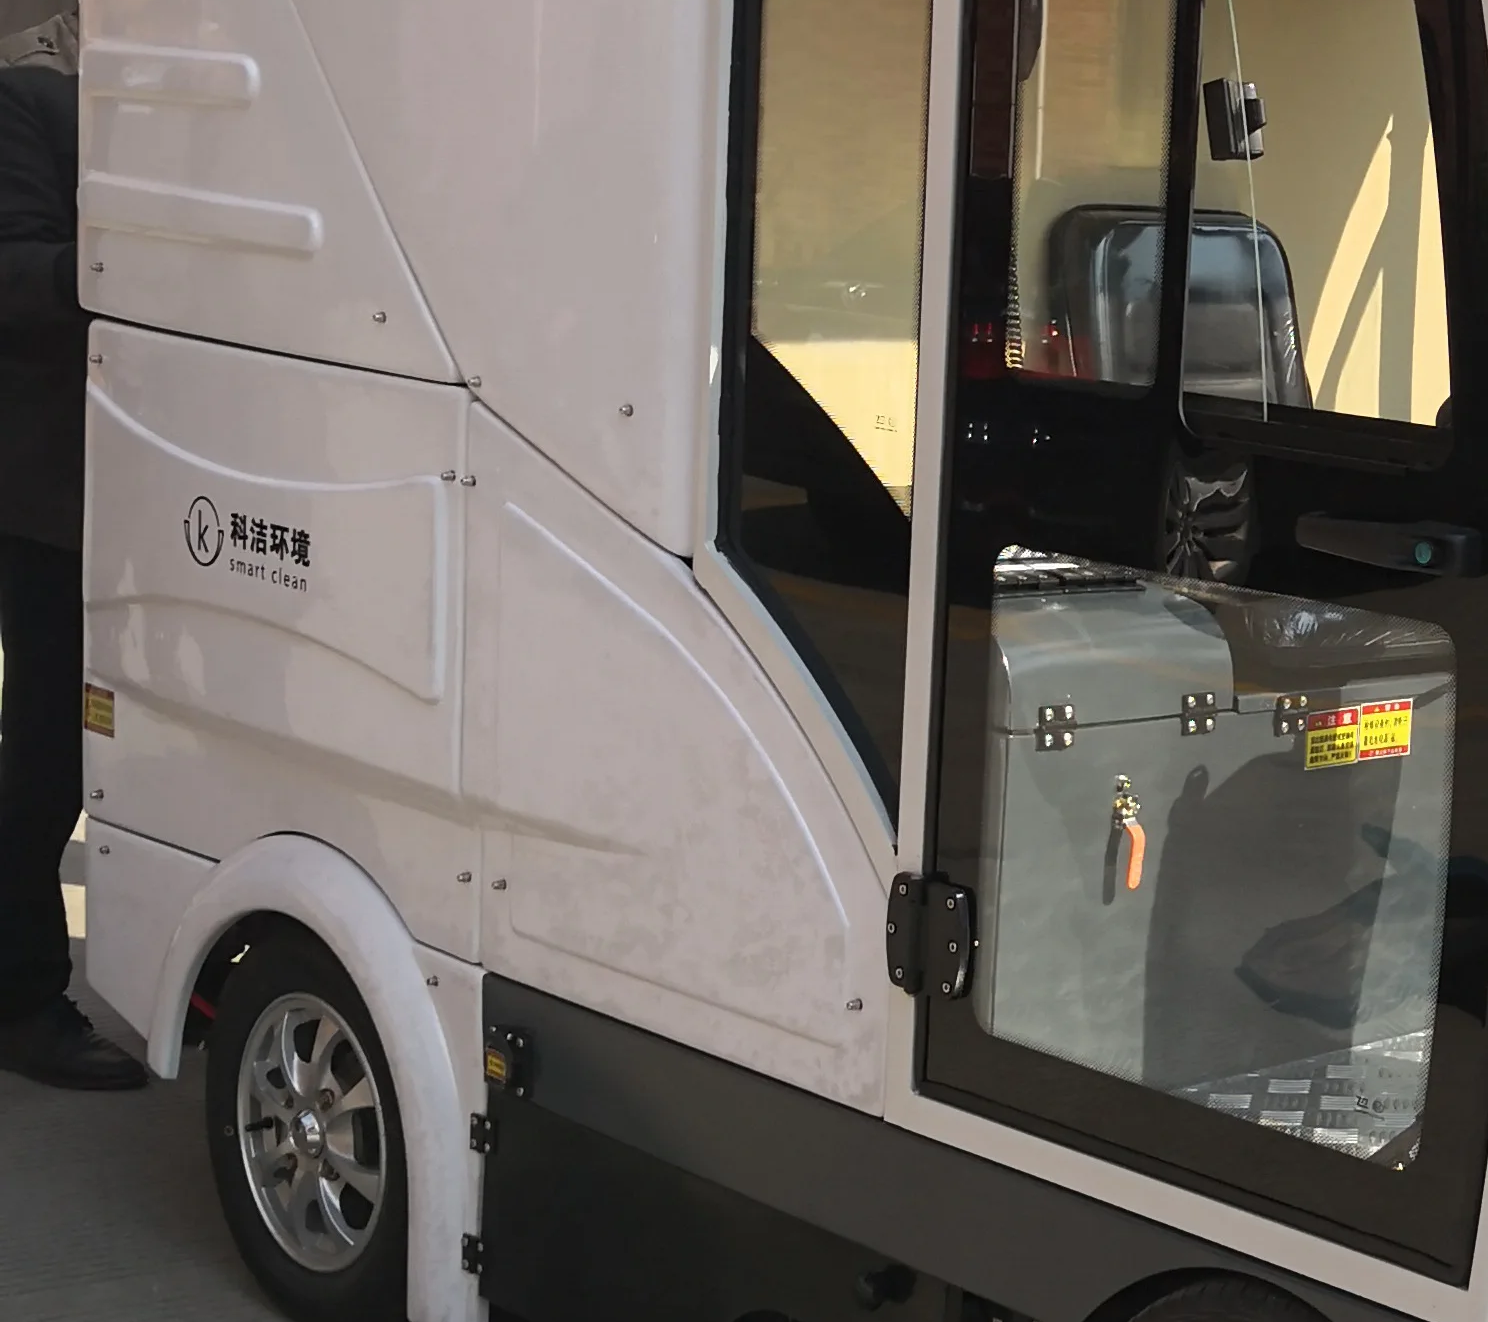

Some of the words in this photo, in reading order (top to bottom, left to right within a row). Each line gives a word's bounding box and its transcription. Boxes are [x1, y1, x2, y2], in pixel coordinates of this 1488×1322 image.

[230, 512, 311, 568] 科洁环境
[229, 557, 266, 580] smart
[271, 567, 308, 592] clean
